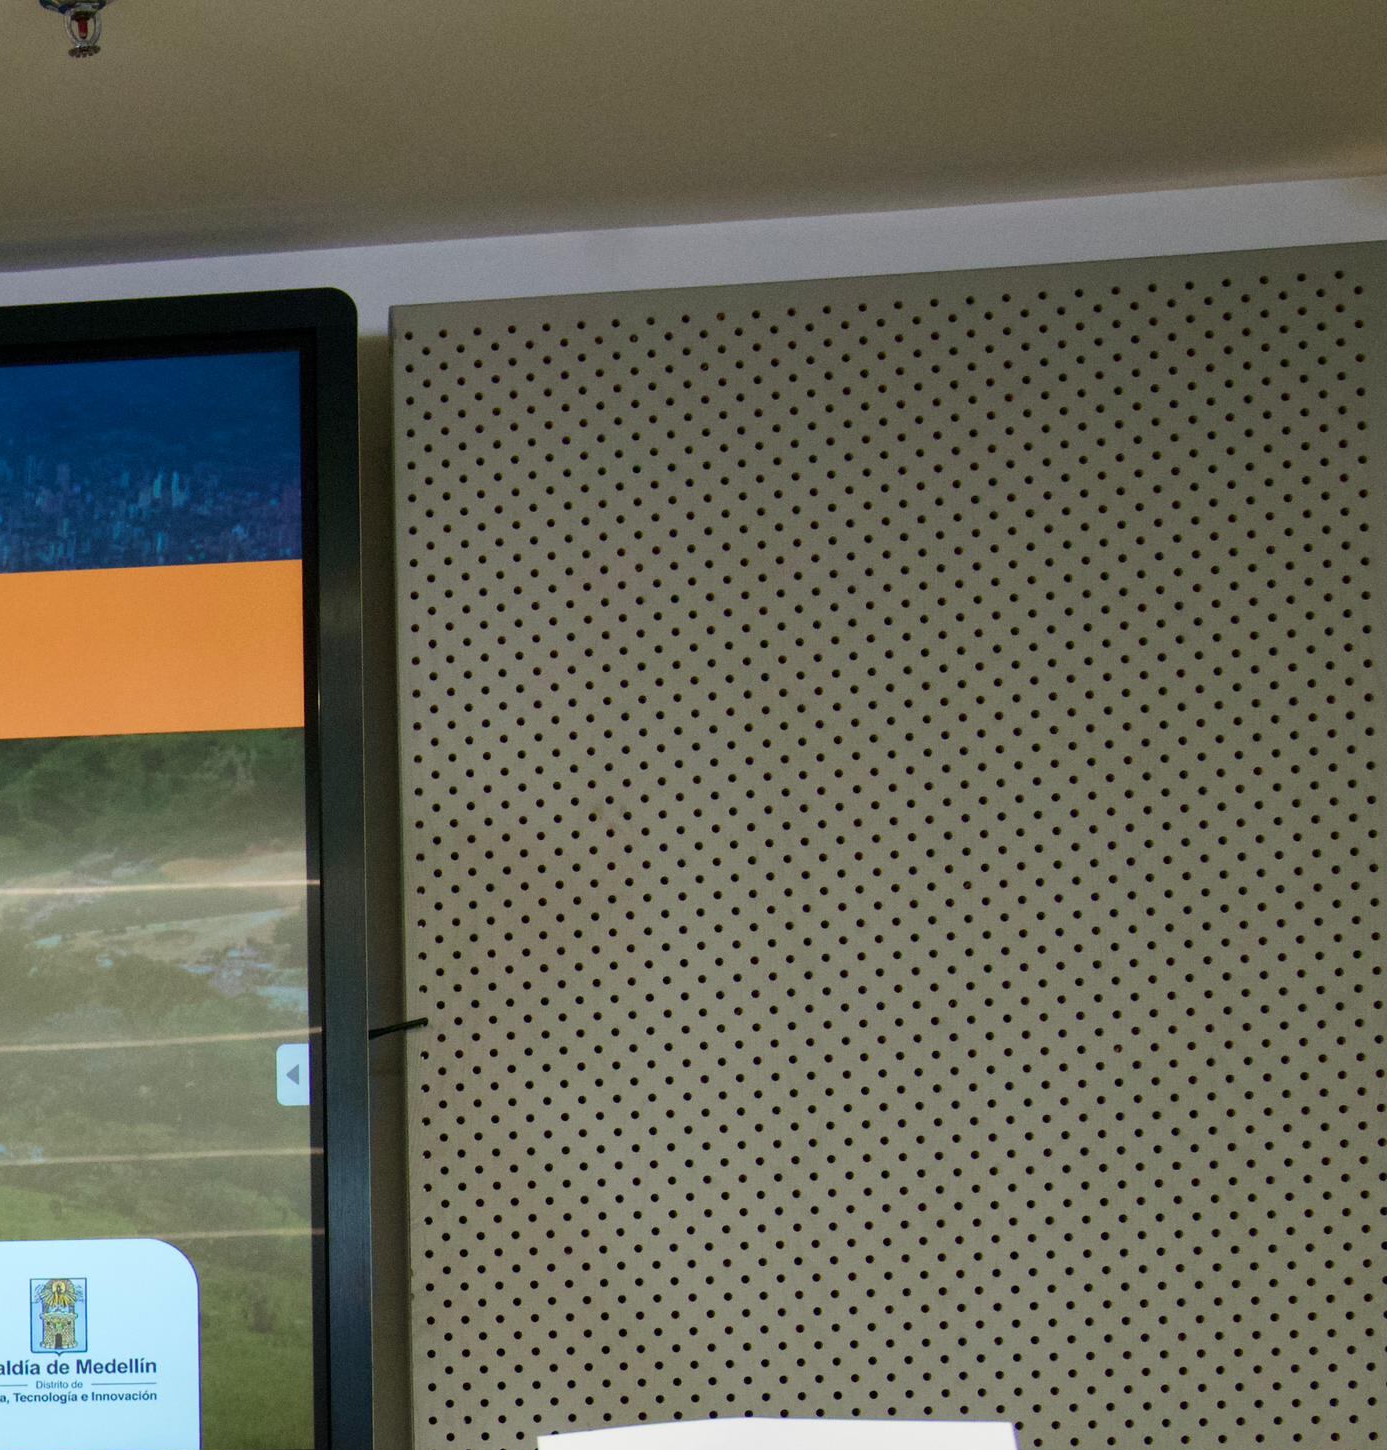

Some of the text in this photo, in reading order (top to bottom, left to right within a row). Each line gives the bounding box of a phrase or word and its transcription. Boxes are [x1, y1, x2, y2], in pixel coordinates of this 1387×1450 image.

[47, 1360, 70, 1375] de
[76, 1357, 157, 1375] Medellín
[36, 1380, 83, 1389] Distrito de
[13, 1392, 77, 1404] Tecnología
[81, 1393, 88, 1402] e
[91, 1390, 157, 1401] Innovación
